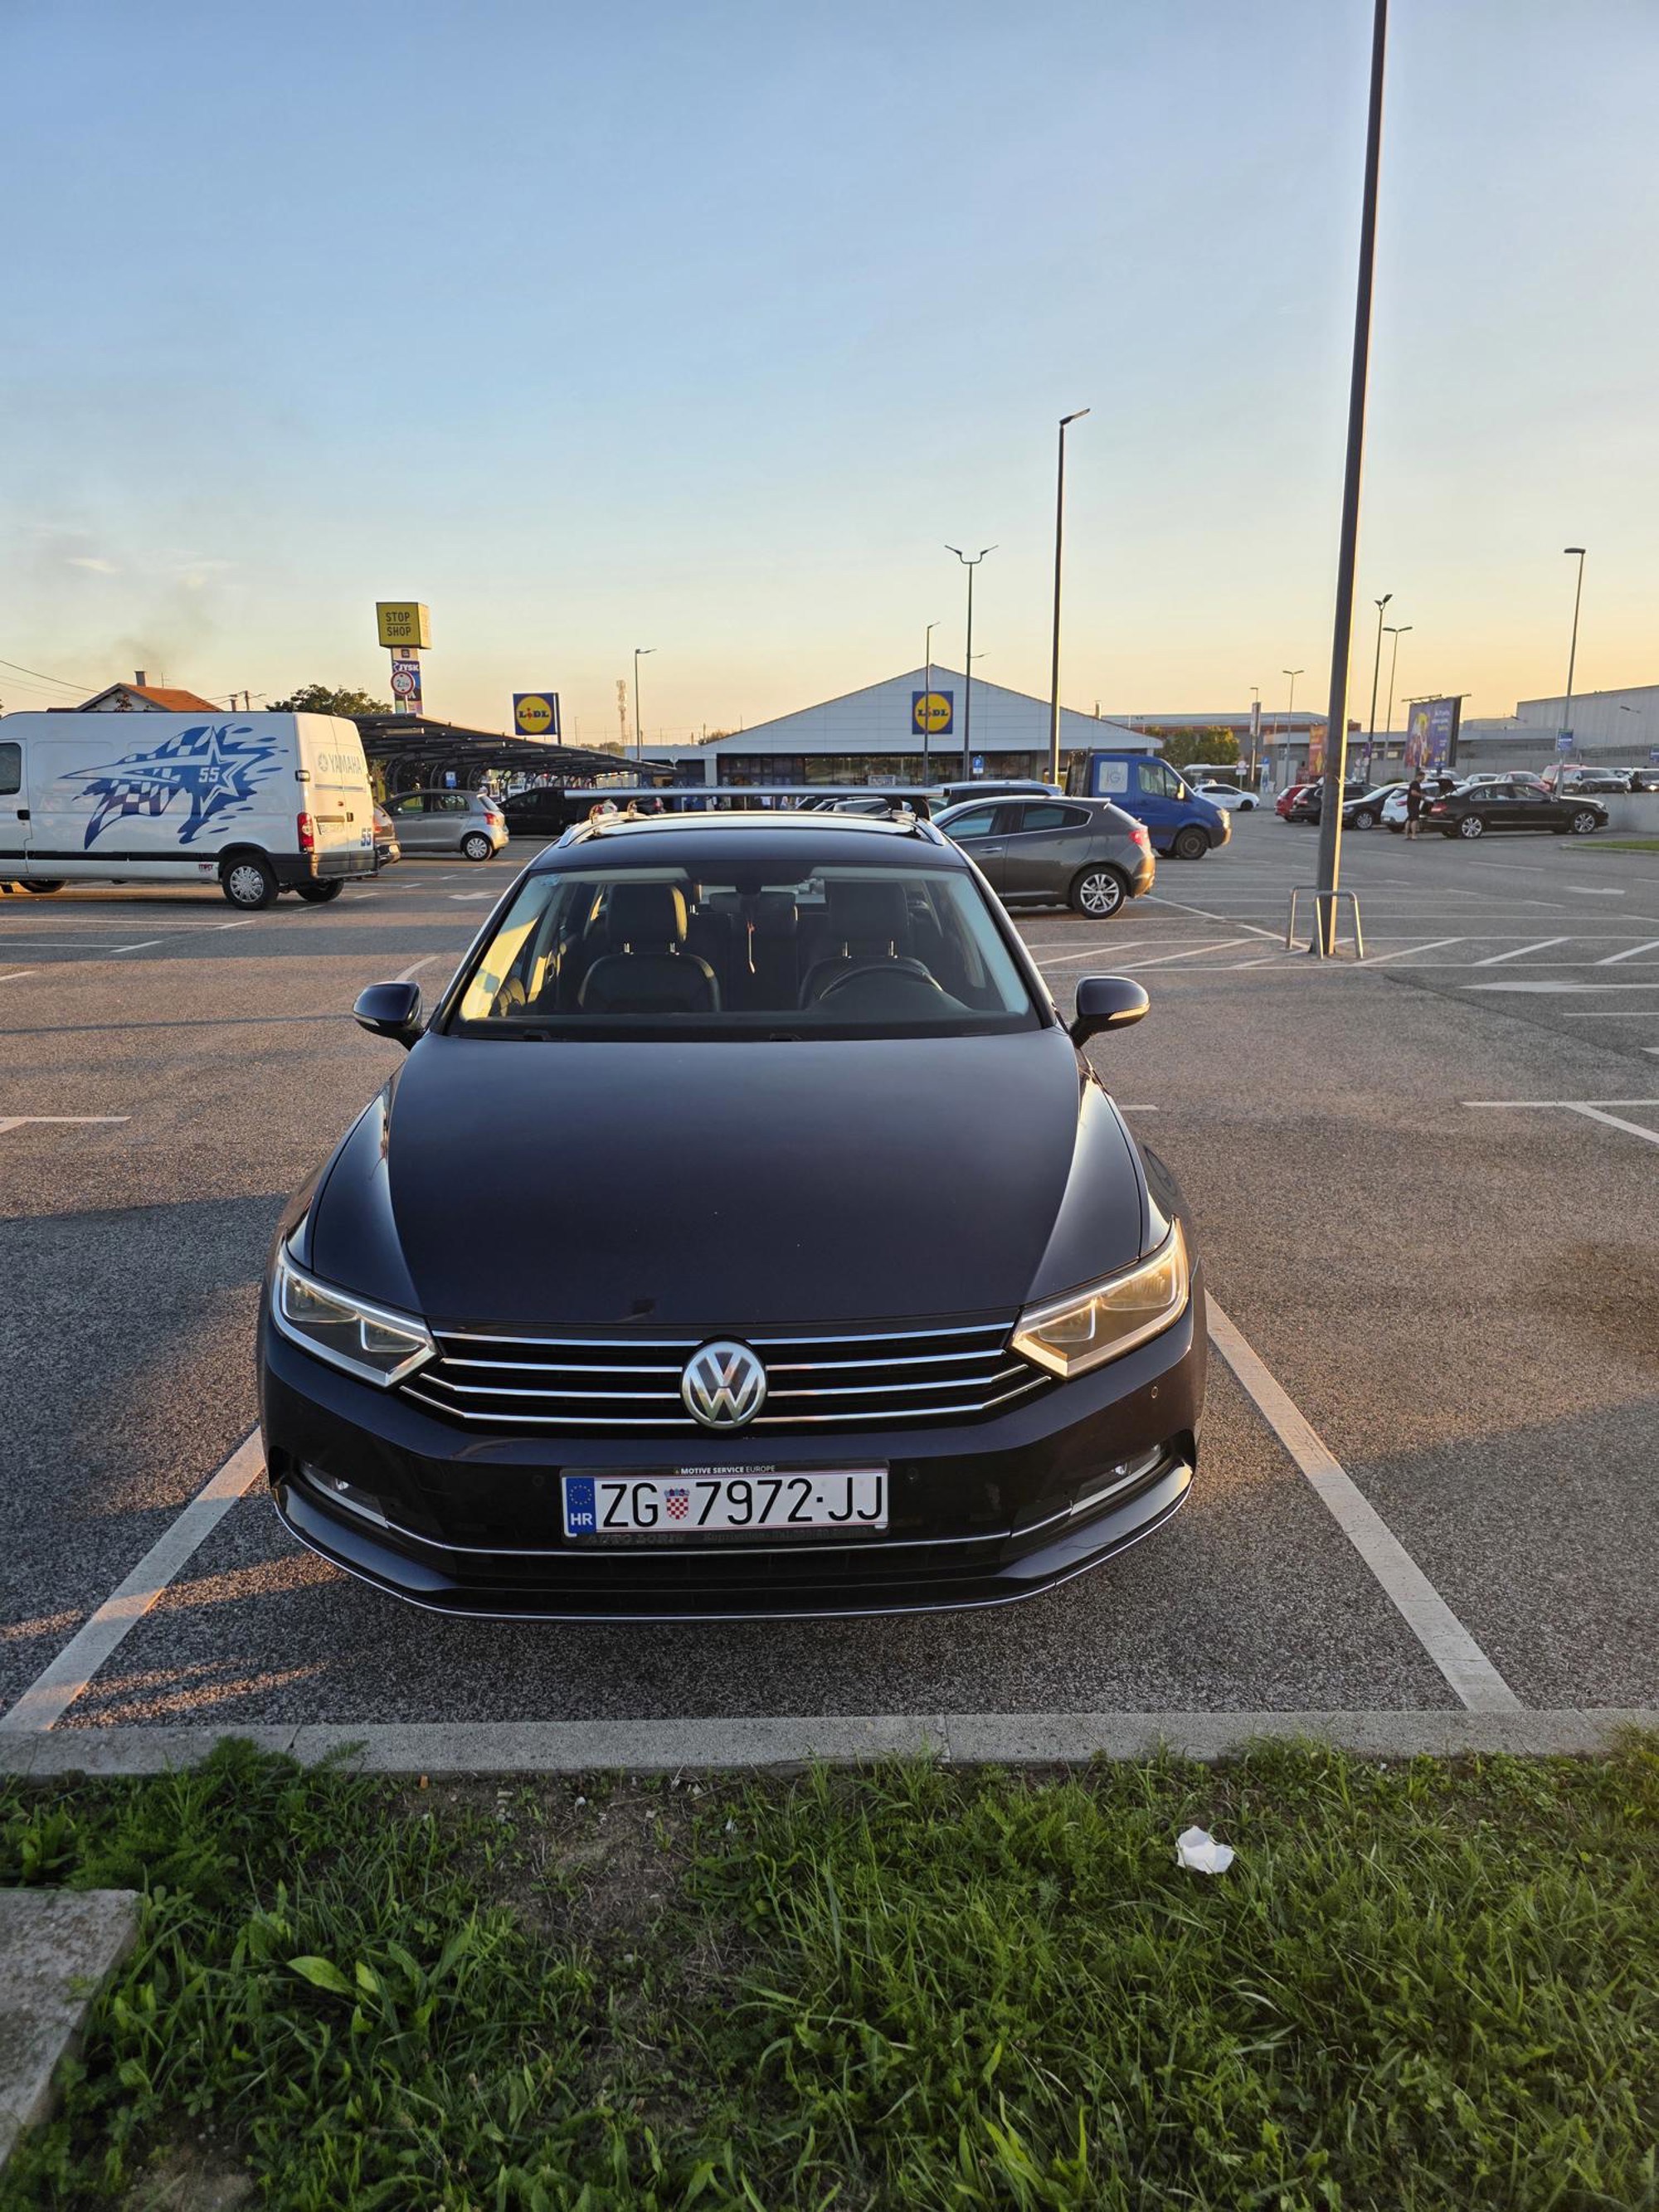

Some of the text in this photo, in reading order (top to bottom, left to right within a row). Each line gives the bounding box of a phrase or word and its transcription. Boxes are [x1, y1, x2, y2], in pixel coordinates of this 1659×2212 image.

[386, 611, 411, 622] STOP
[387, 626, 411, 637] SHOP
[328, 753, 362, 775] YAMAHA
[198, 767, 220, 783] 55
[360, 828, 372, 846] 55
[746, 1465, 776, 1473] EUROPE
[601, 1482, 659, 1527] ZG
[570, 1512, 593, 1526] HR
